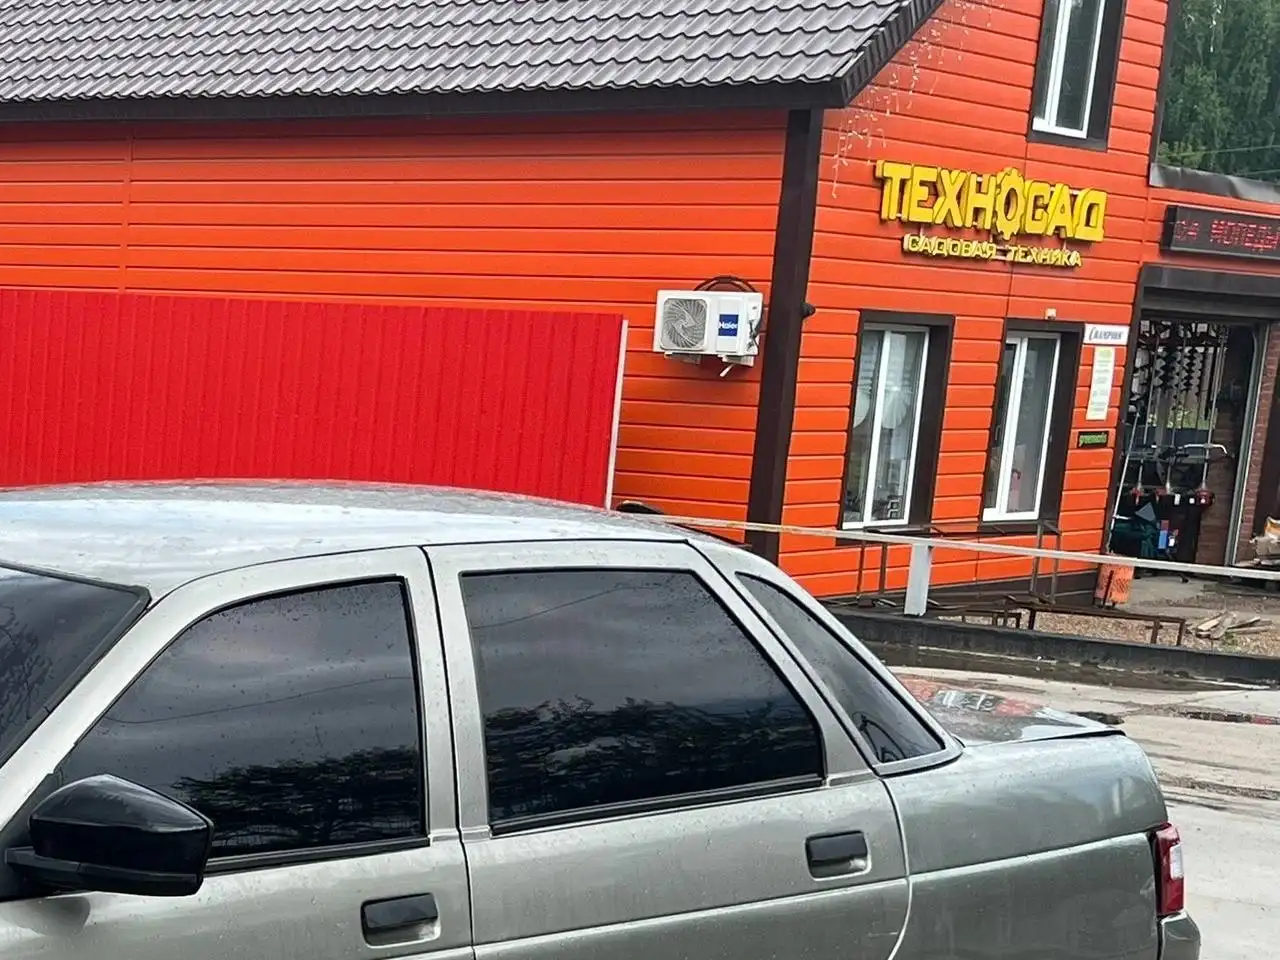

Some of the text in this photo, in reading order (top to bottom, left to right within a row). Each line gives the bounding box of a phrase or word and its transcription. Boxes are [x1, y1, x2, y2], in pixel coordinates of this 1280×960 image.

[876, 160, 1107, 241] ТЕХНОСАД
[903, 233, 1082, 267] САДОВАЯ ТЕХНИКА
[718, 320, 737, 330] Haier
